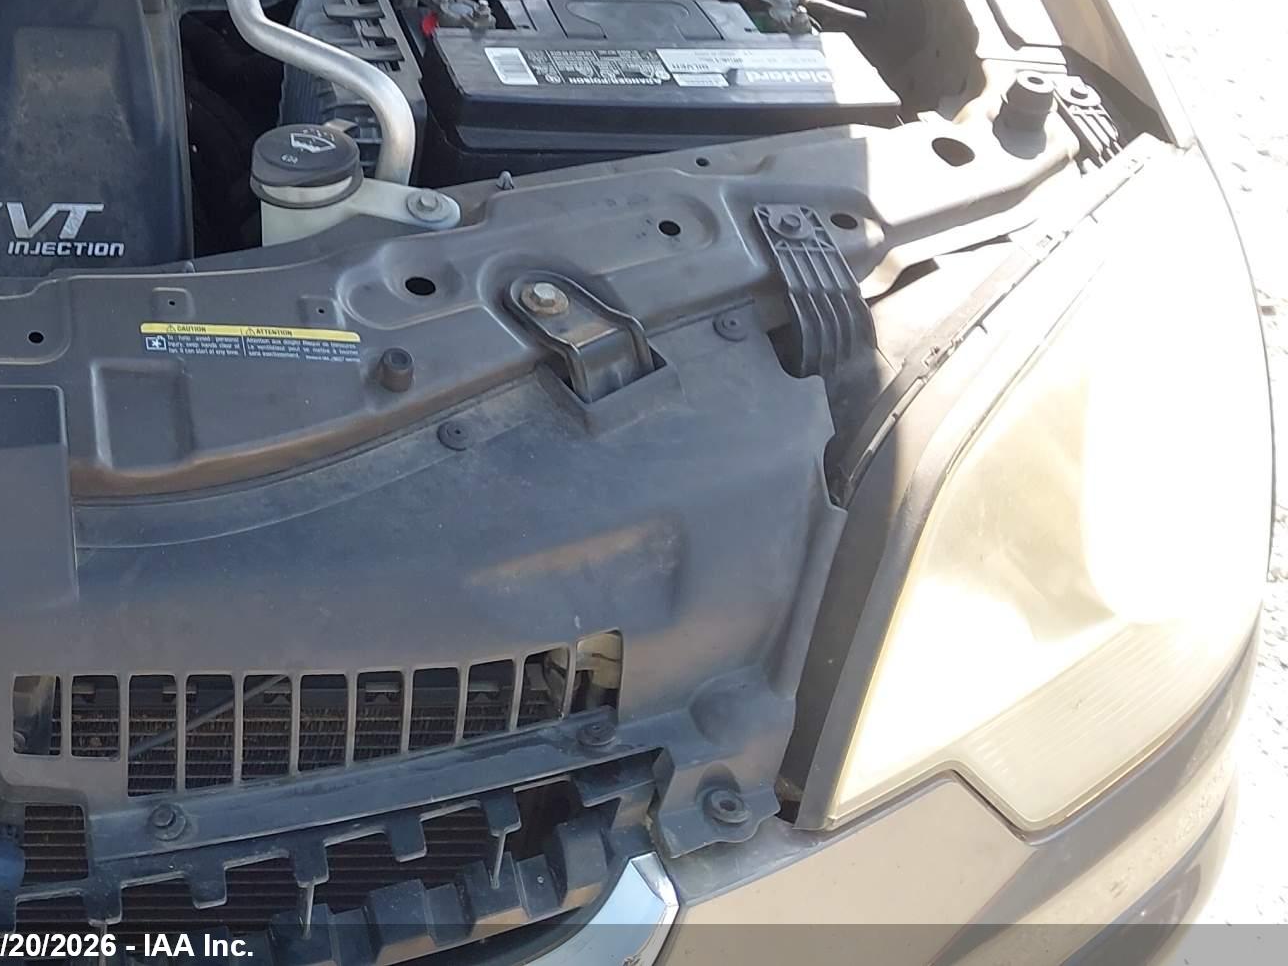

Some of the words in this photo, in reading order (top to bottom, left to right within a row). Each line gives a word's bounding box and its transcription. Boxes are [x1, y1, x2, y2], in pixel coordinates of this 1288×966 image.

[7, 239, 126, 258] INJECTION
[177, 324, 207, 333] CAUTION
[256, 328, 293, 336] ATTENTION
